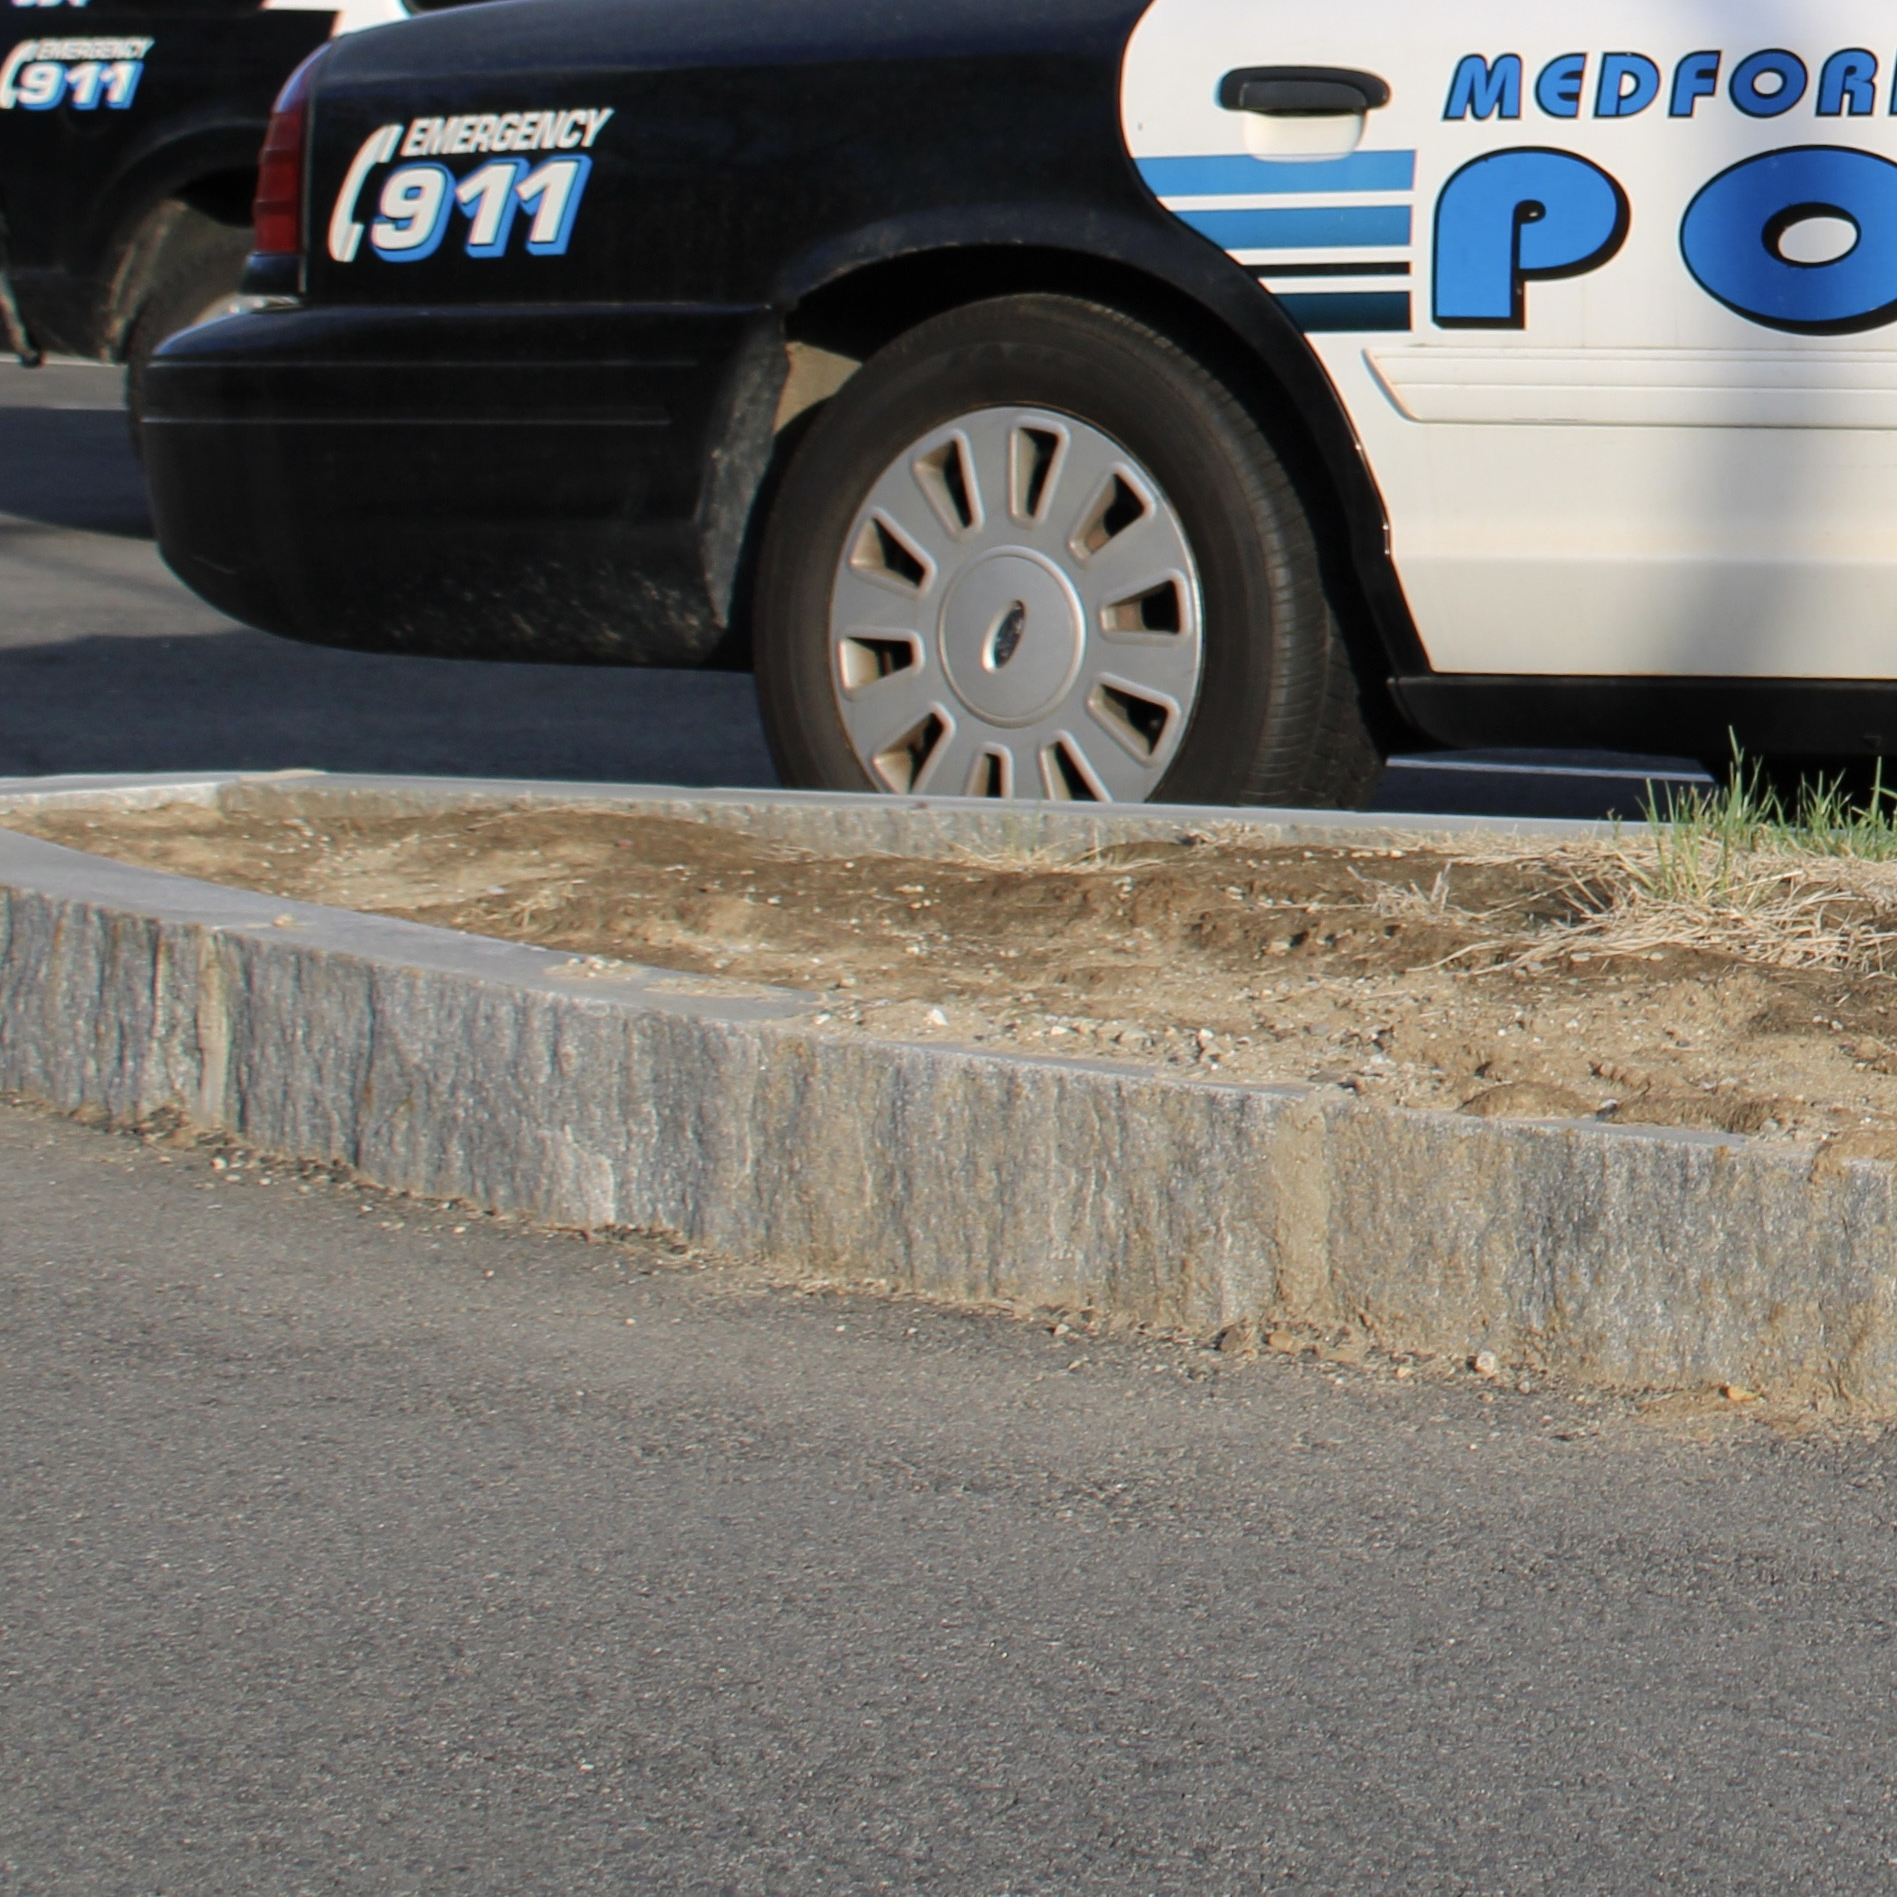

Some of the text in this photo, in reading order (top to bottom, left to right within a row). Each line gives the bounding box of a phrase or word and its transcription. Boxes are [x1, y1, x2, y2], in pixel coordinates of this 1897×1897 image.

[35, 36, 155, 60] EMERGENCY
[17, 60, 144, 111] 911
[400, 107, 614, 157] EMERGENCY
[371, 154, 593, 263] 911
